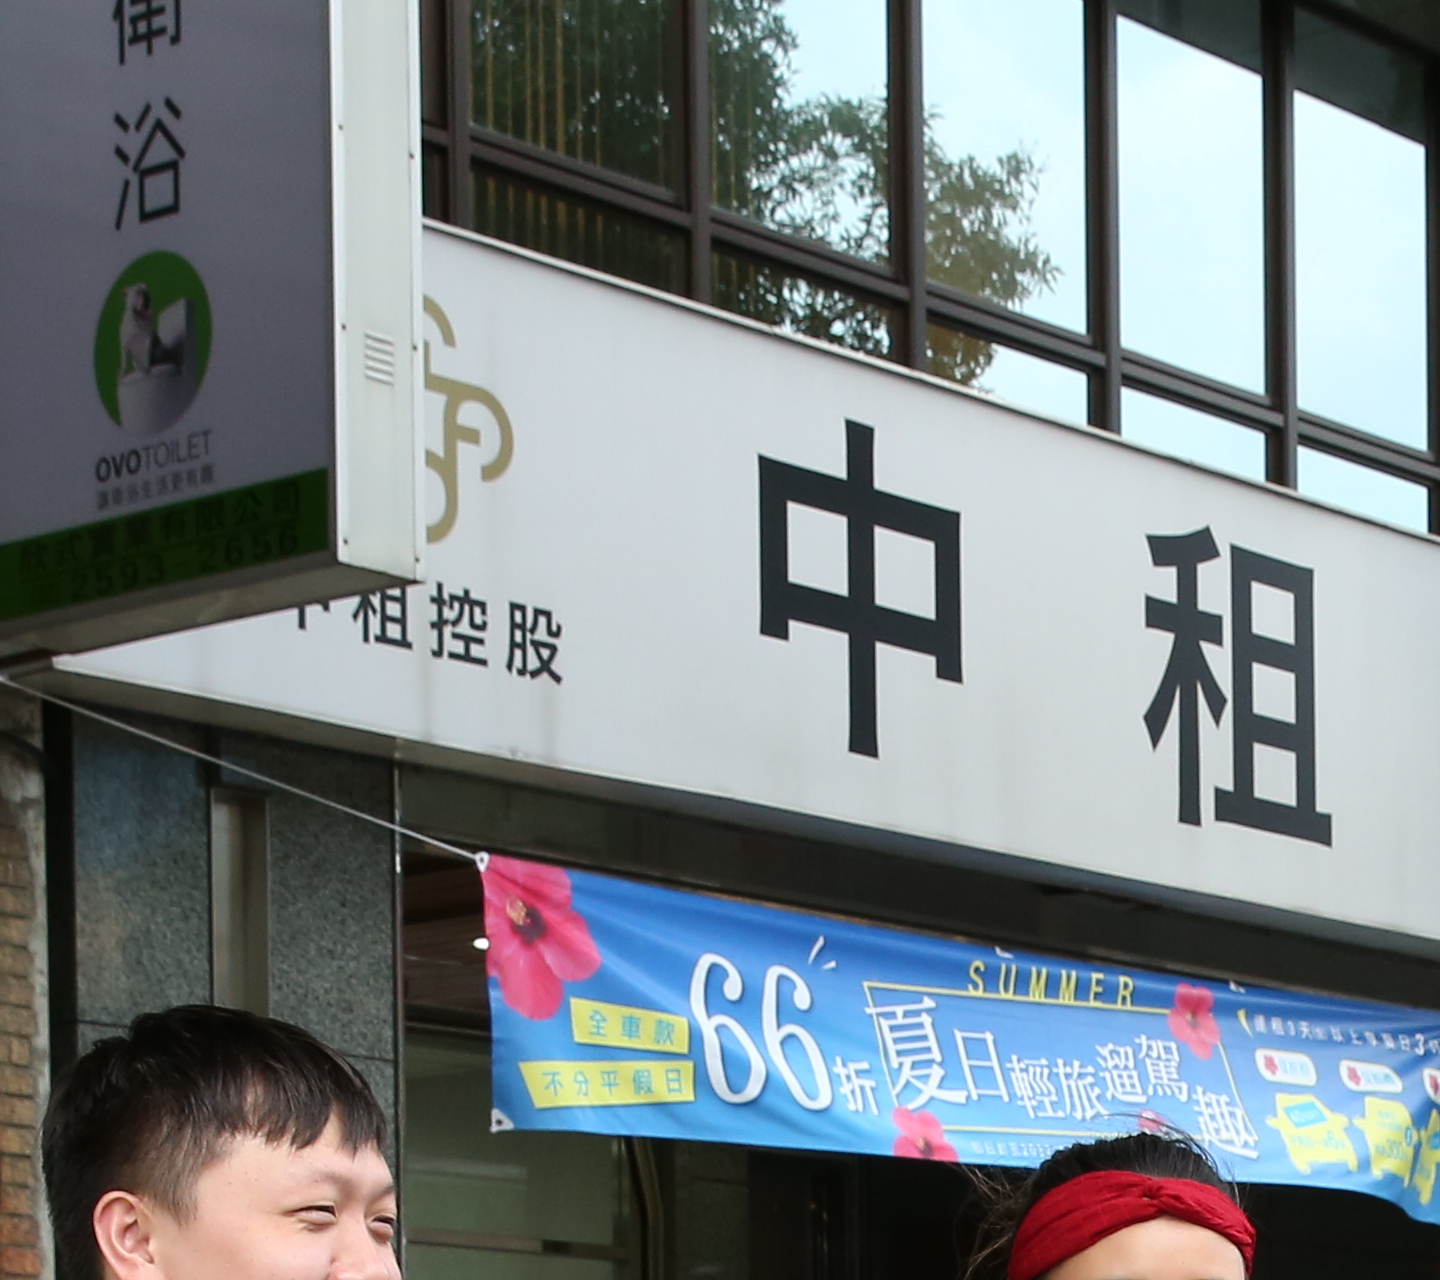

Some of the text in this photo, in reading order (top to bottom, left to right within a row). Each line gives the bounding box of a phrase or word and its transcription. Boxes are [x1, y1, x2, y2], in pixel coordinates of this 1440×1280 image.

[95, 428, 212, 482] OVOTOILET
[297, 582, 563, 685] 租控股
[968, 960, 1136, 1007] SUMMER
[587, 1009, 675, 1046] 全車款
[542, 1067, 684, 1096] 不分平假日
